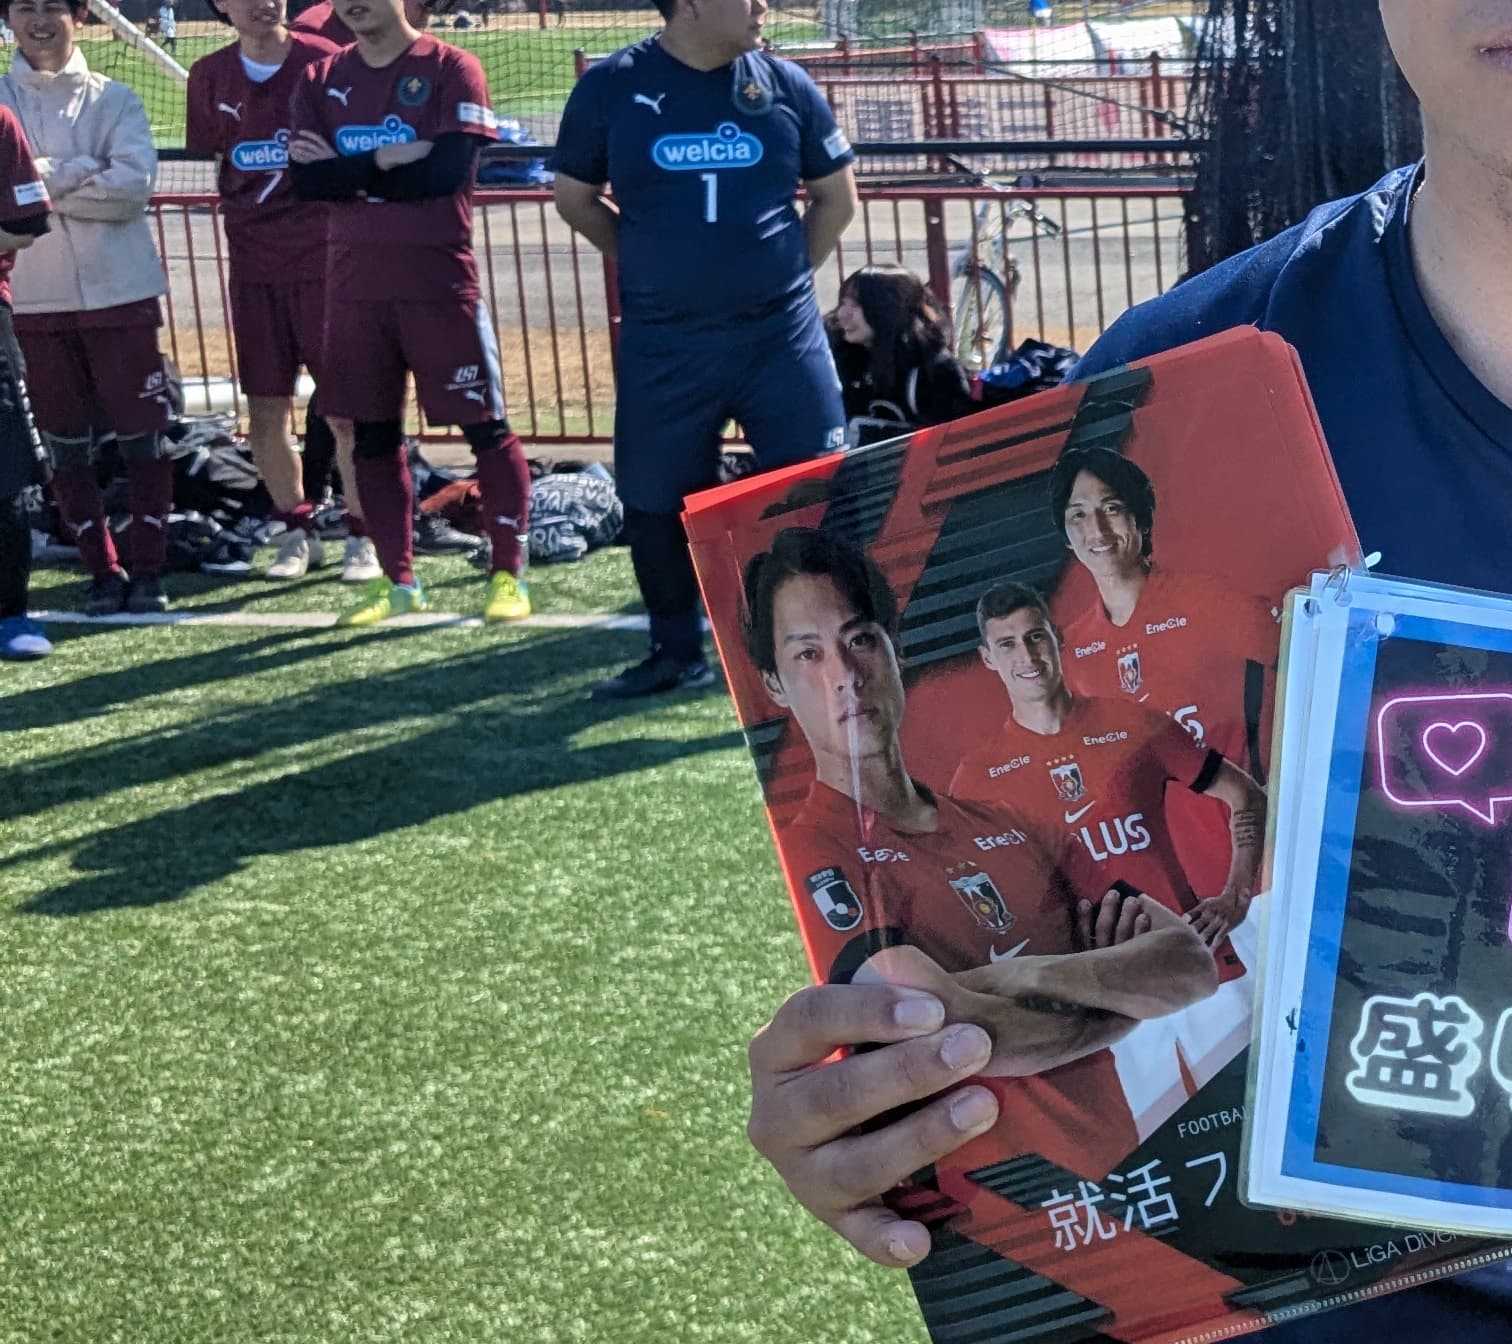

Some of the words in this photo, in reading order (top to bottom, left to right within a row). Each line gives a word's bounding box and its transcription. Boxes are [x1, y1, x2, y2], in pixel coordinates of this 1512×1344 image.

[662, 139, 751, 163] welcia
[263, 170, 283, 204] 7
[701, 173, 718, 223] 1
